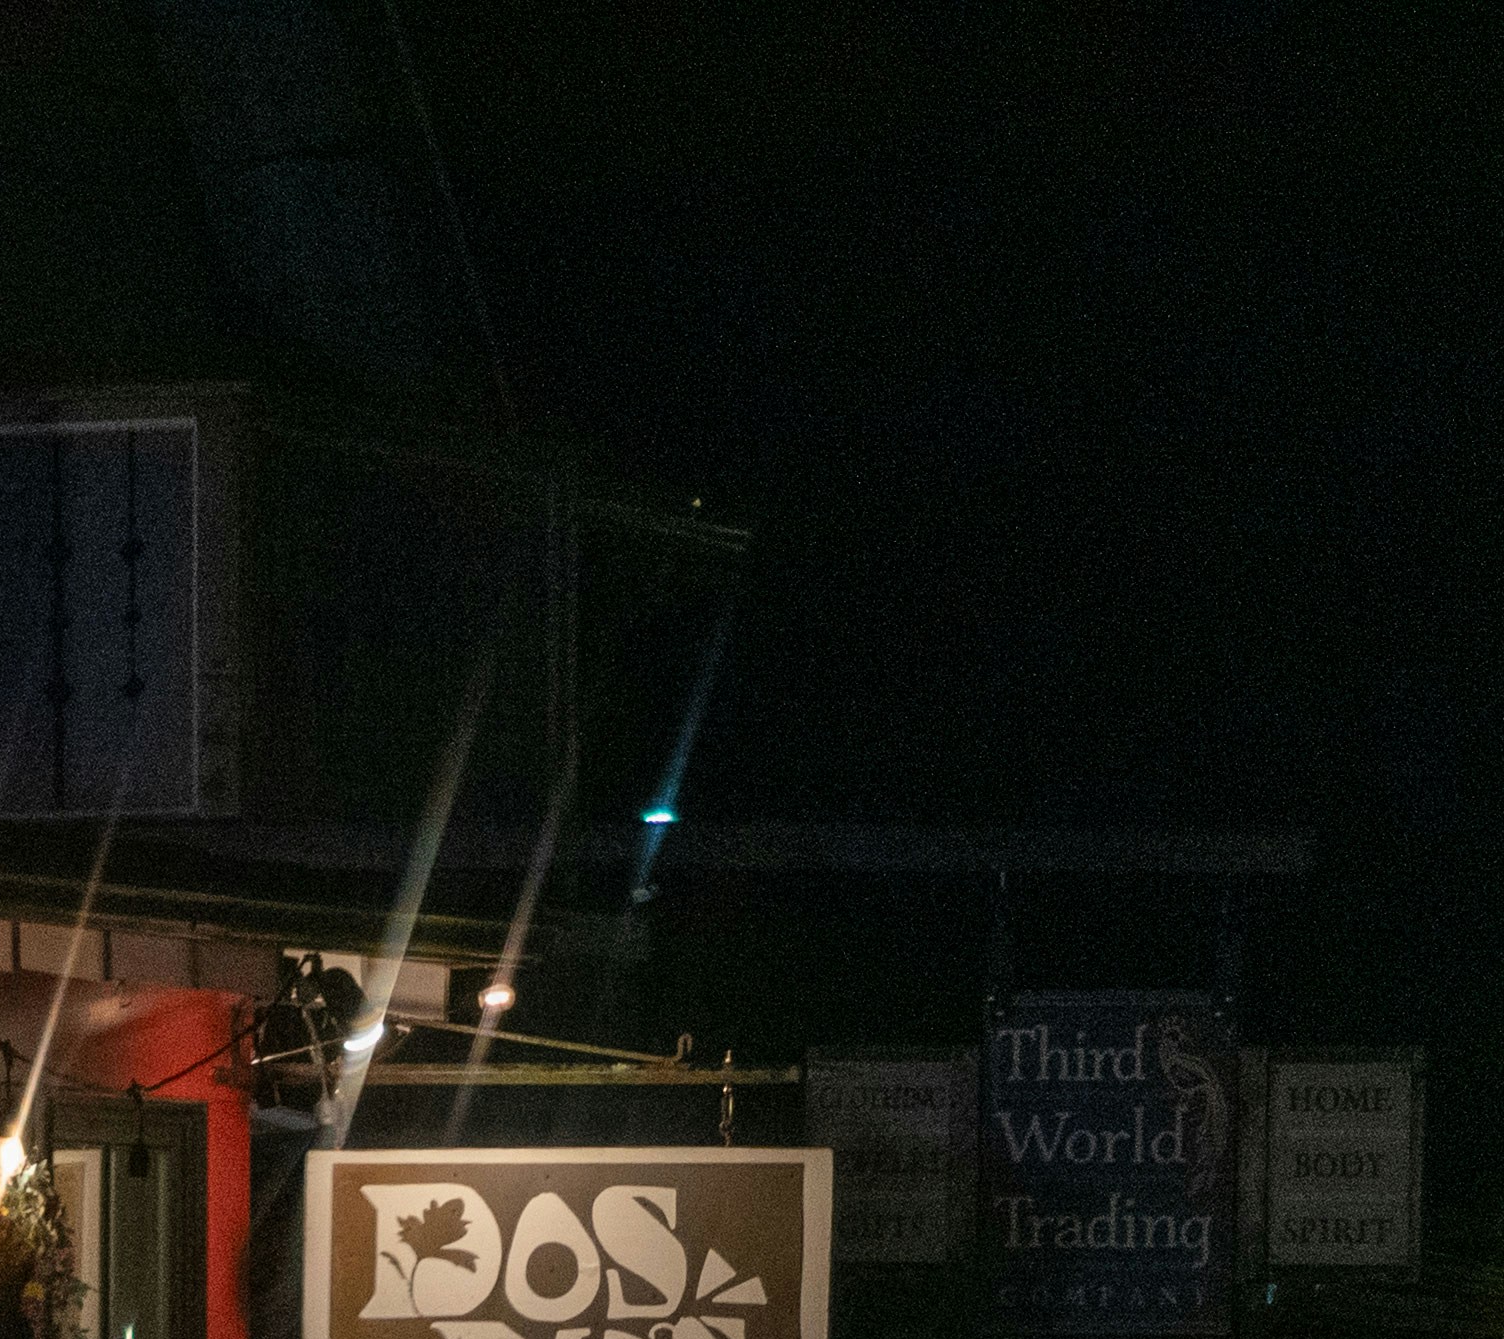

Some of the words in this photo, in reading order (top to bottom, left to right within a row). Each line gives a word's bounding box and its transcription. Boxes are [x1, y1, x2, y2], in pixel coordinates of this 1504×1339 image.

[997, 1021, 1150, 1085] Third
[1288, 1084, 1396, 1115] HOME
[993, 1103, 1191, 1167] World
[1294, 1151, 1388, 1181] BODY
[358, 1181, 689, 1324] DOS
[993, 1189, 1213, 1272] Trading
[1282, 1217, 1395, 1247] SPIRIT
[996, 1284, 1208, 1310] COMPANY
